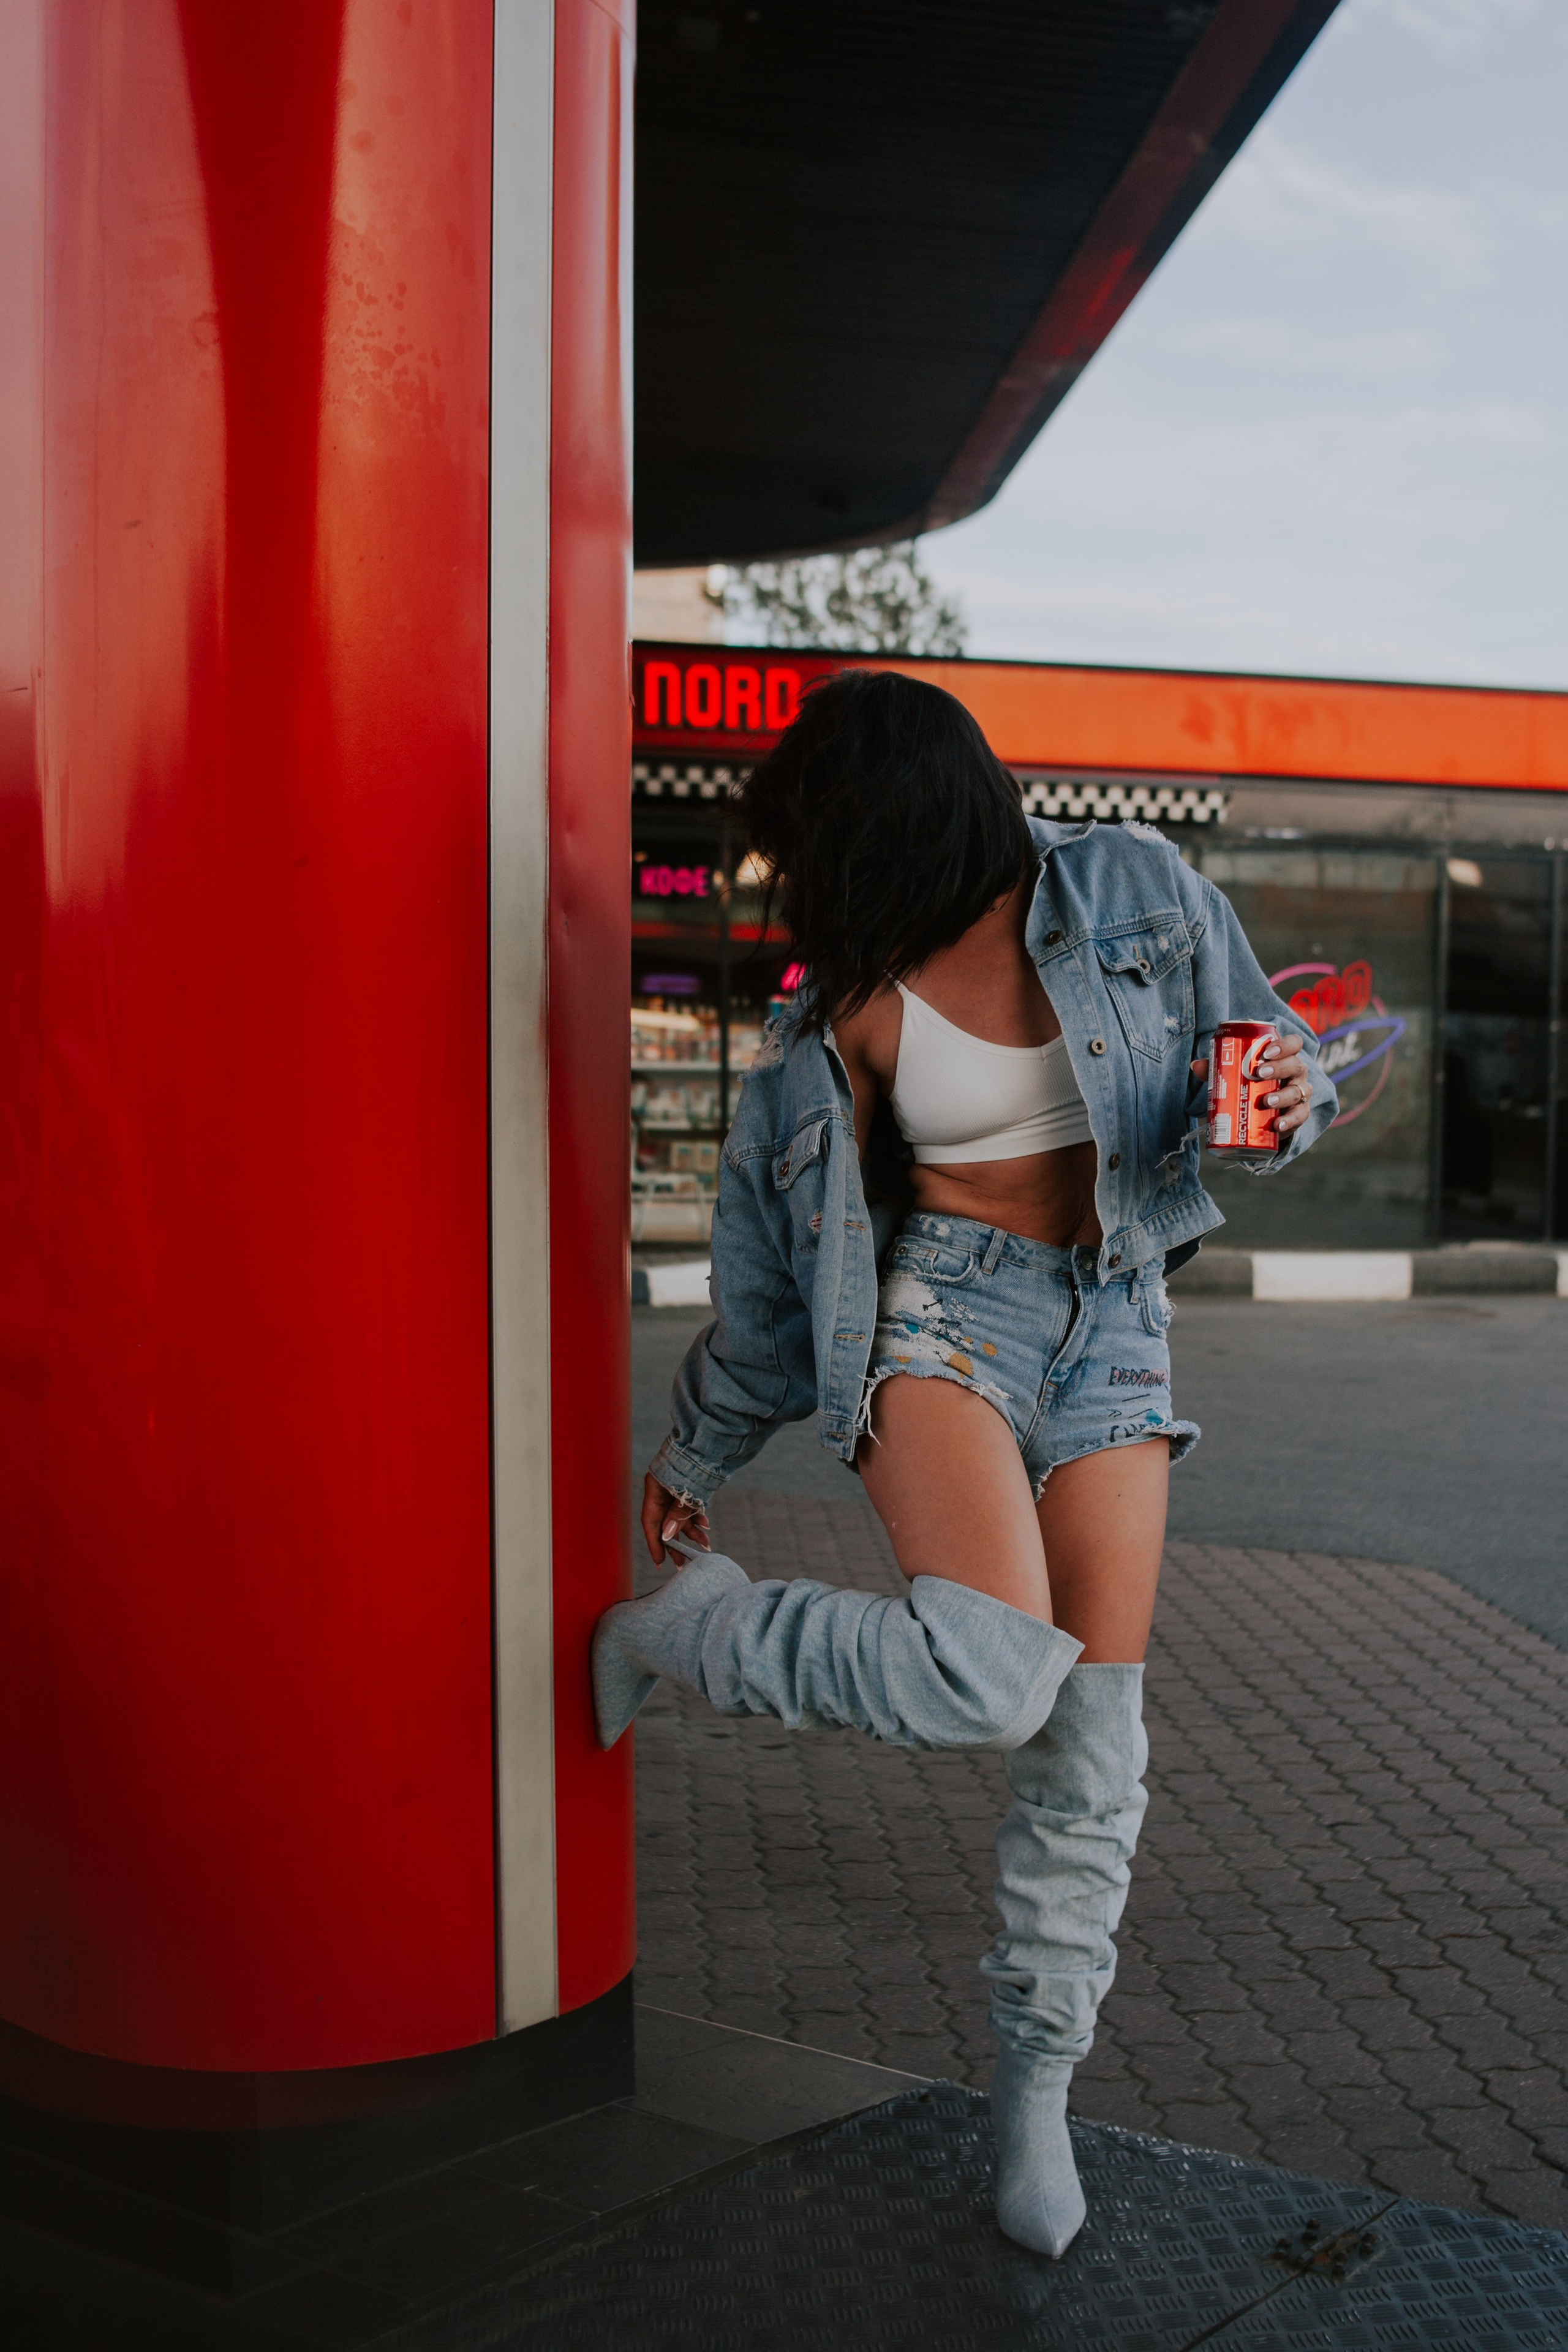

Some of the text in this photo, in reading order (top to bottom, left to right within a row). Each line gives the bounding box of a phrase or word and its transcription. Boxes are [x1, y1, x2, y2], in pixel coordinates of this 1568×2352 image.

[644, 661, 802, 731] NORD
[1238, 1084, 1248, 1145] RECYCLE ME
[1108, 1366, 1165, 1389] EVERYTHING
